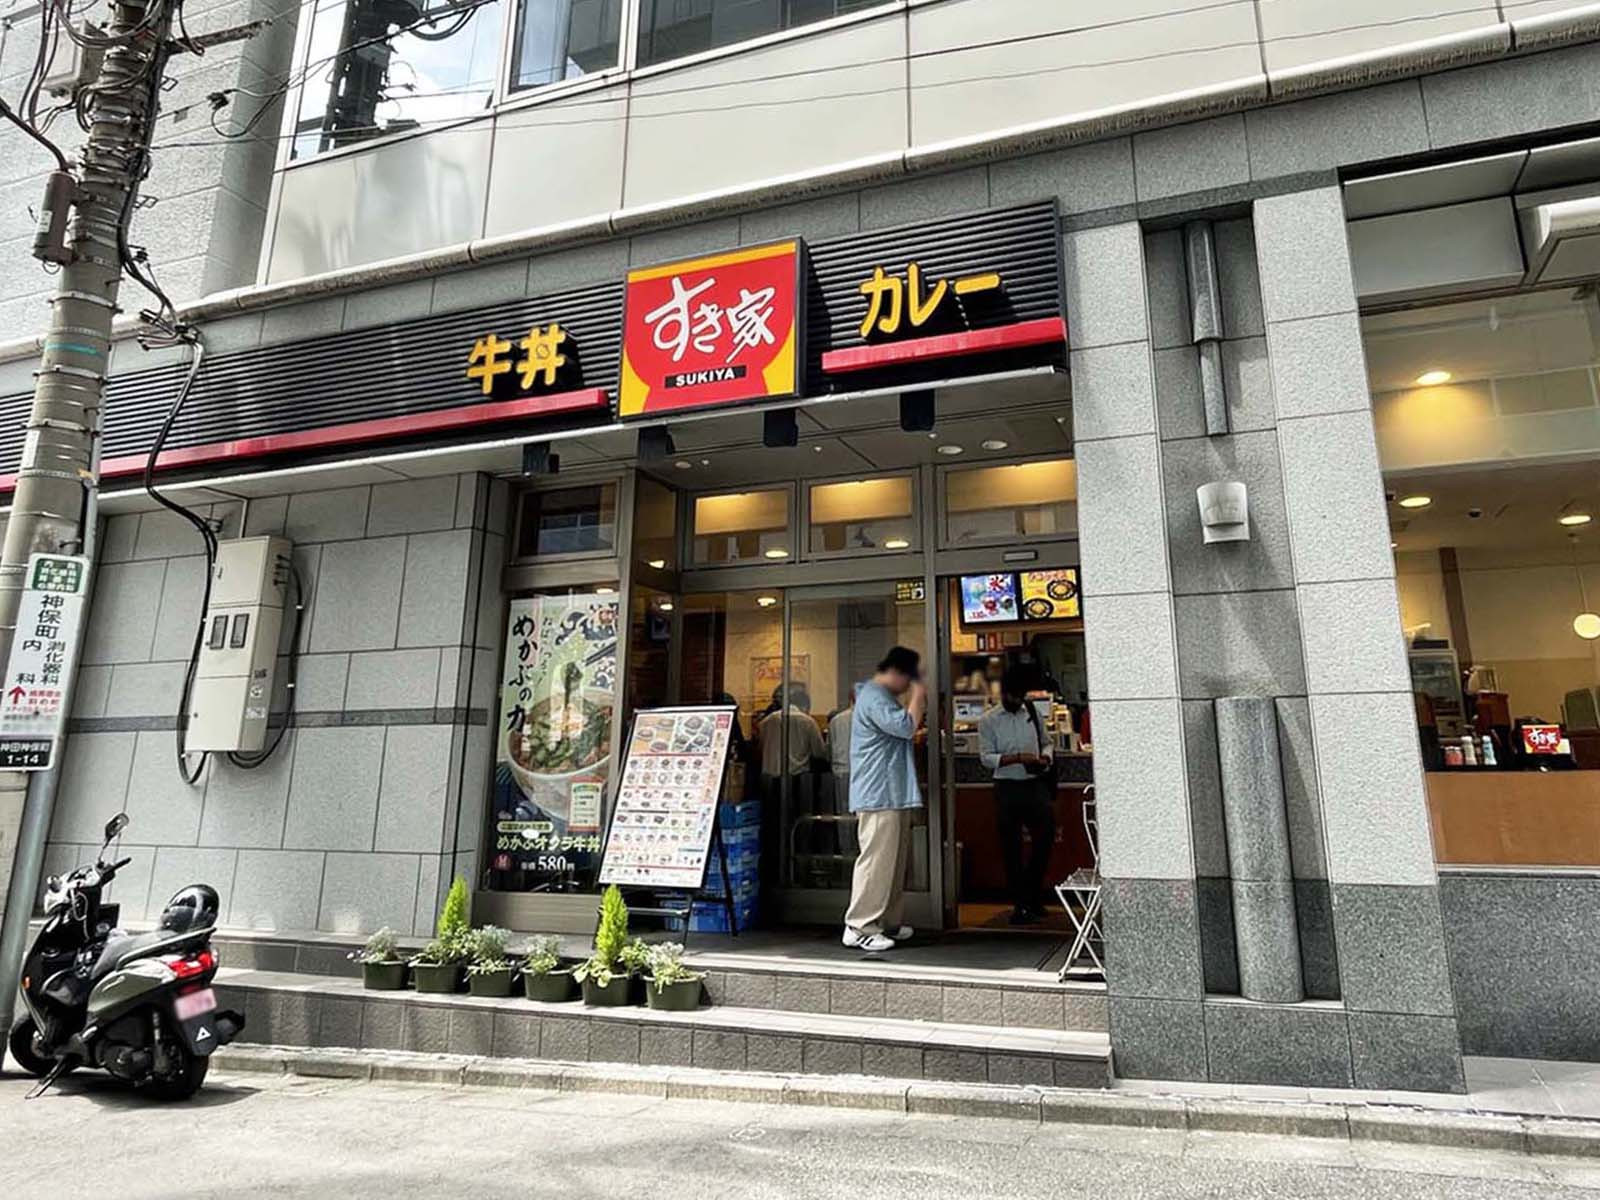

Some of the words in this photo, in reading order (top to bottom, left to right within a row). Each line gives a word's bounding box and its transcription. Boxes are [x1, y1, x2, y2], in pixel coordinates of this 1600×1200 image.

[644, 276, 777, 364] すき家
[859, 262, 1001, 338] カレー
[466, 323, 567, 395] 牛丼
[676, 369, 736, 387] SUKIYA
[35, 594, 65, 639] 神保町
[508, 615, 538, 733] めかぶの力
[7, 754, 39, 764] 1-14
